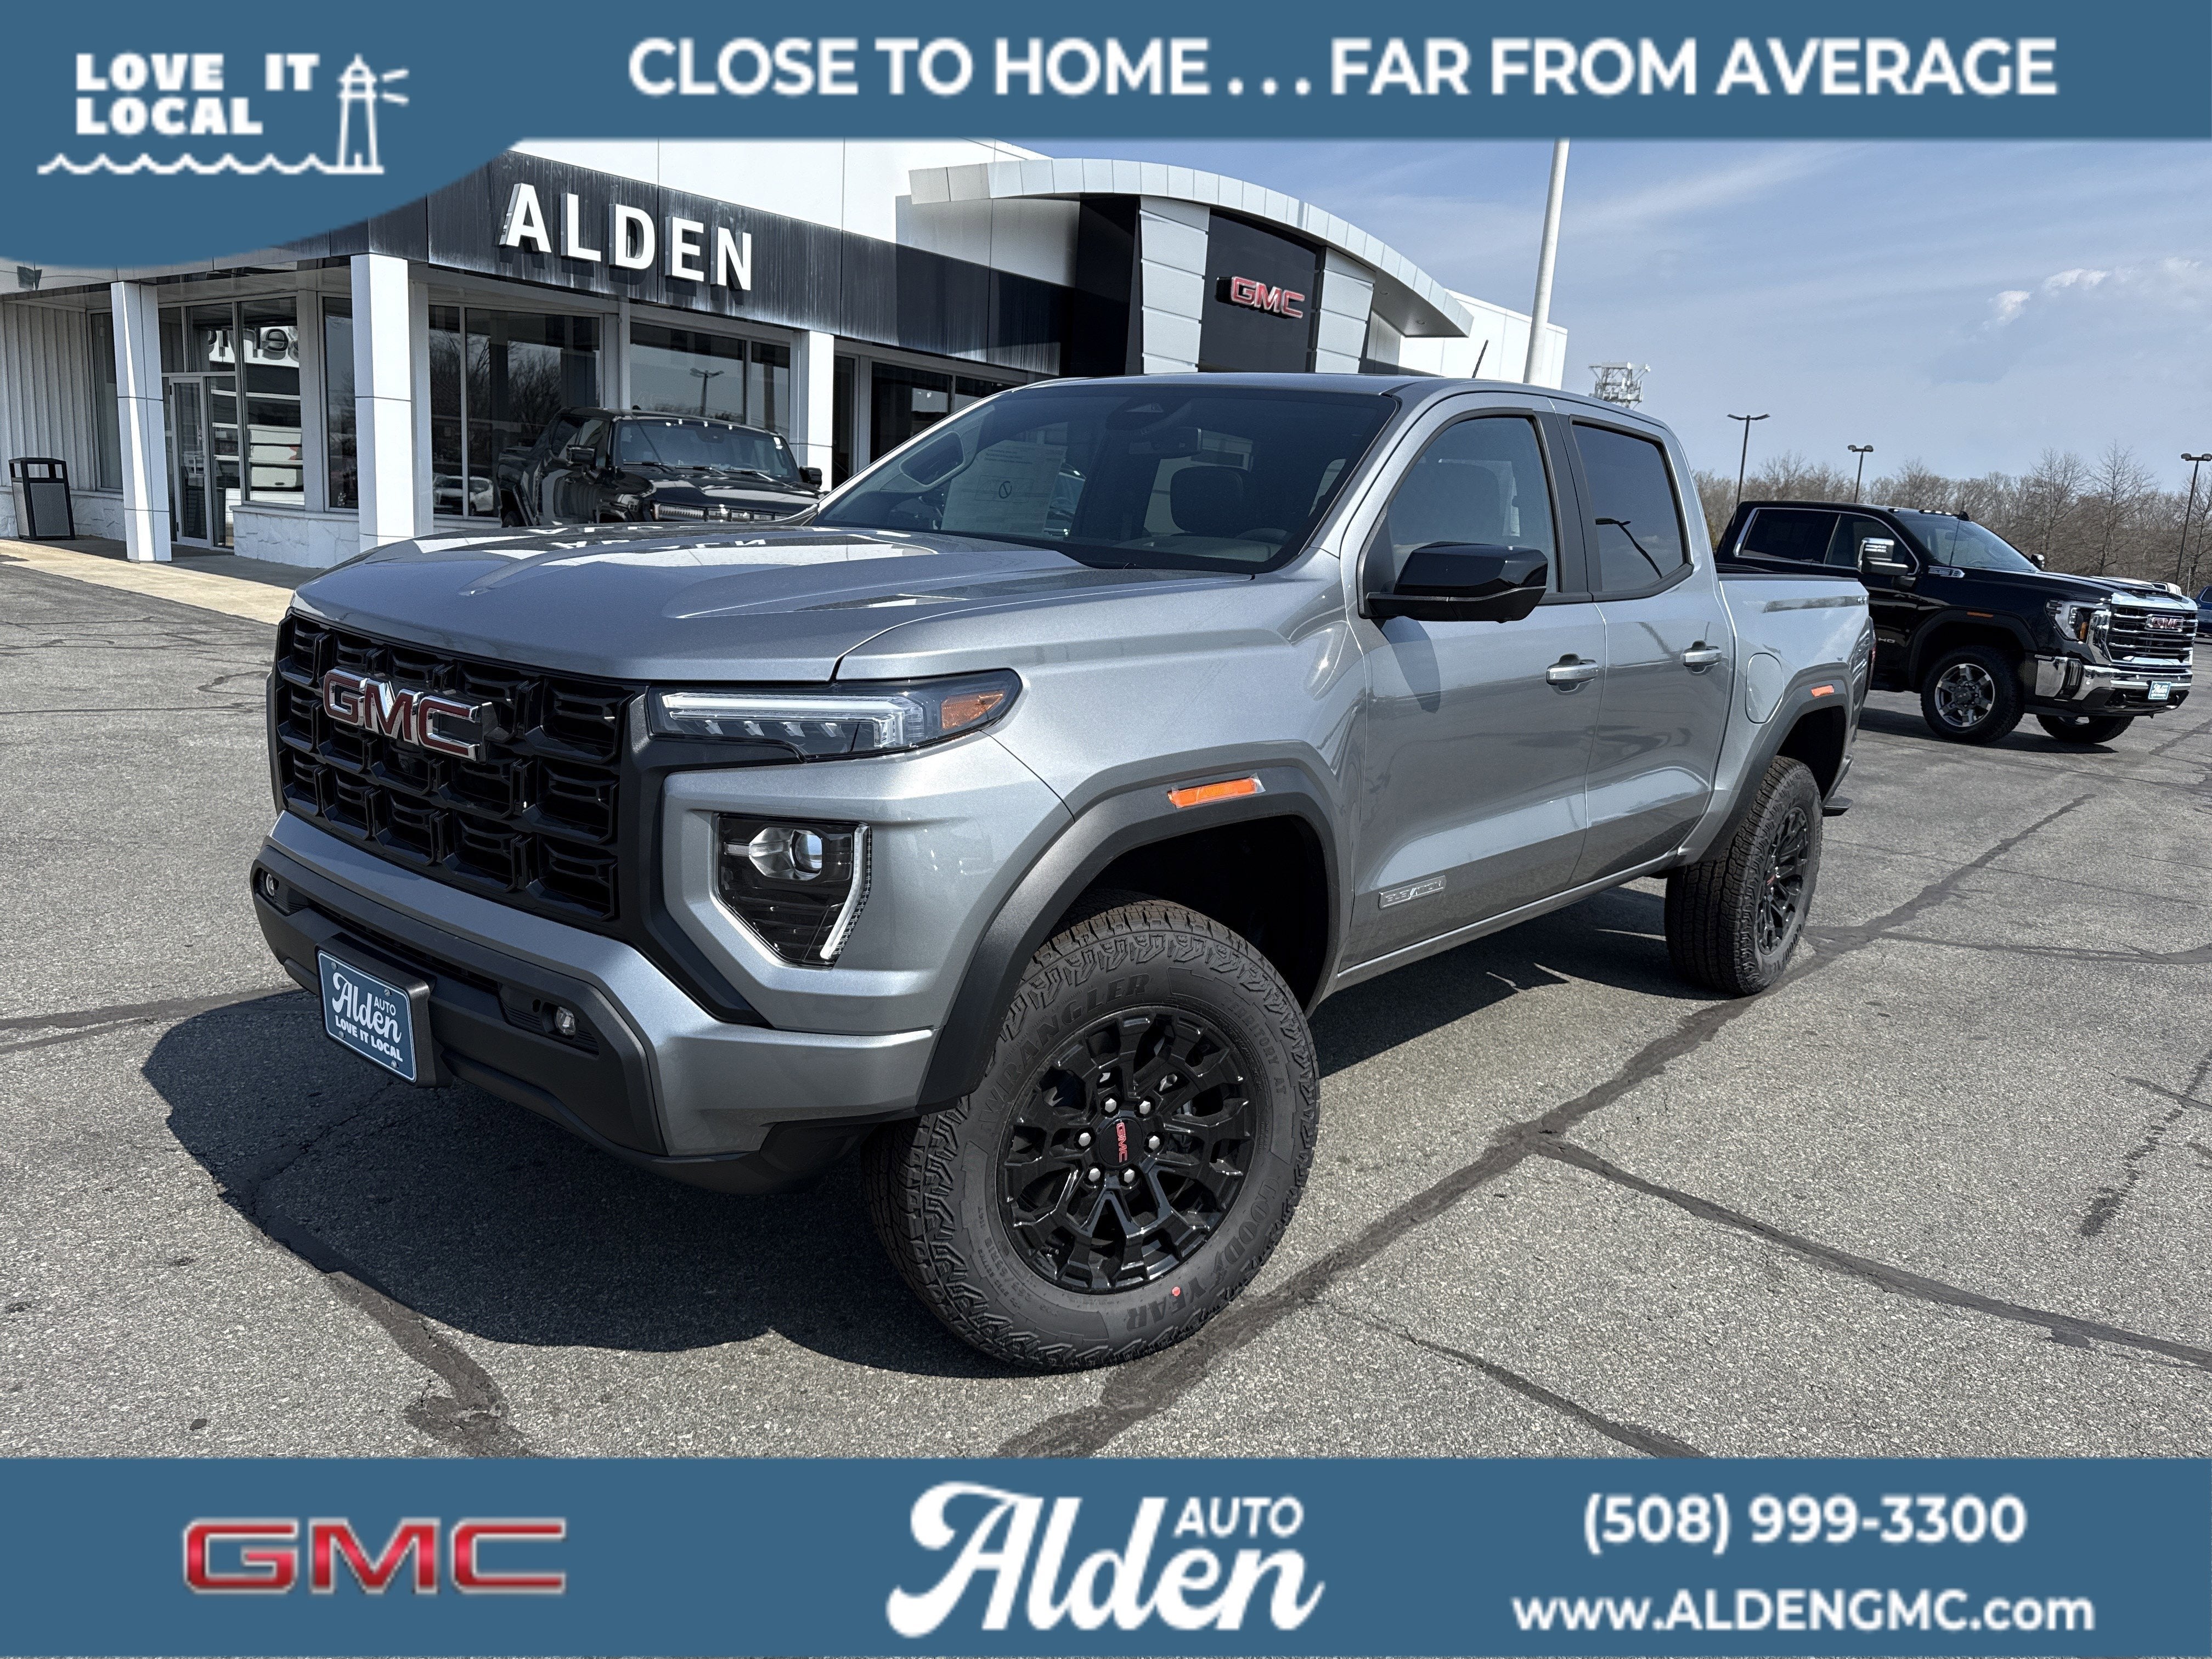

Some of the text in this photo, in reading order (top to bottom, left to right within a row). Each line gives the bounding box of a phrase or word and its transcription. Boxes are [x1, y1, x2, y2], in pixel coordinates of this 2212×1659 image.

[500, 183, 752, 291] ALDEN
[1231, 276, 1305, 318] GMC
[2152, 617, 2183, 629] GMC
[324, 669, 479, 761] GMC
[332, 972, 402, 1043] Alden
[374, 996, 396, 1016] AUTO
[335, 1014, 403, 1062] LOVE IT LOCAL
[978, 973, 1150, 1125] WRANGLER
[1273, 1076, 1287, 1095] AT
[1116, 1122, 1128, 1163] GMC
